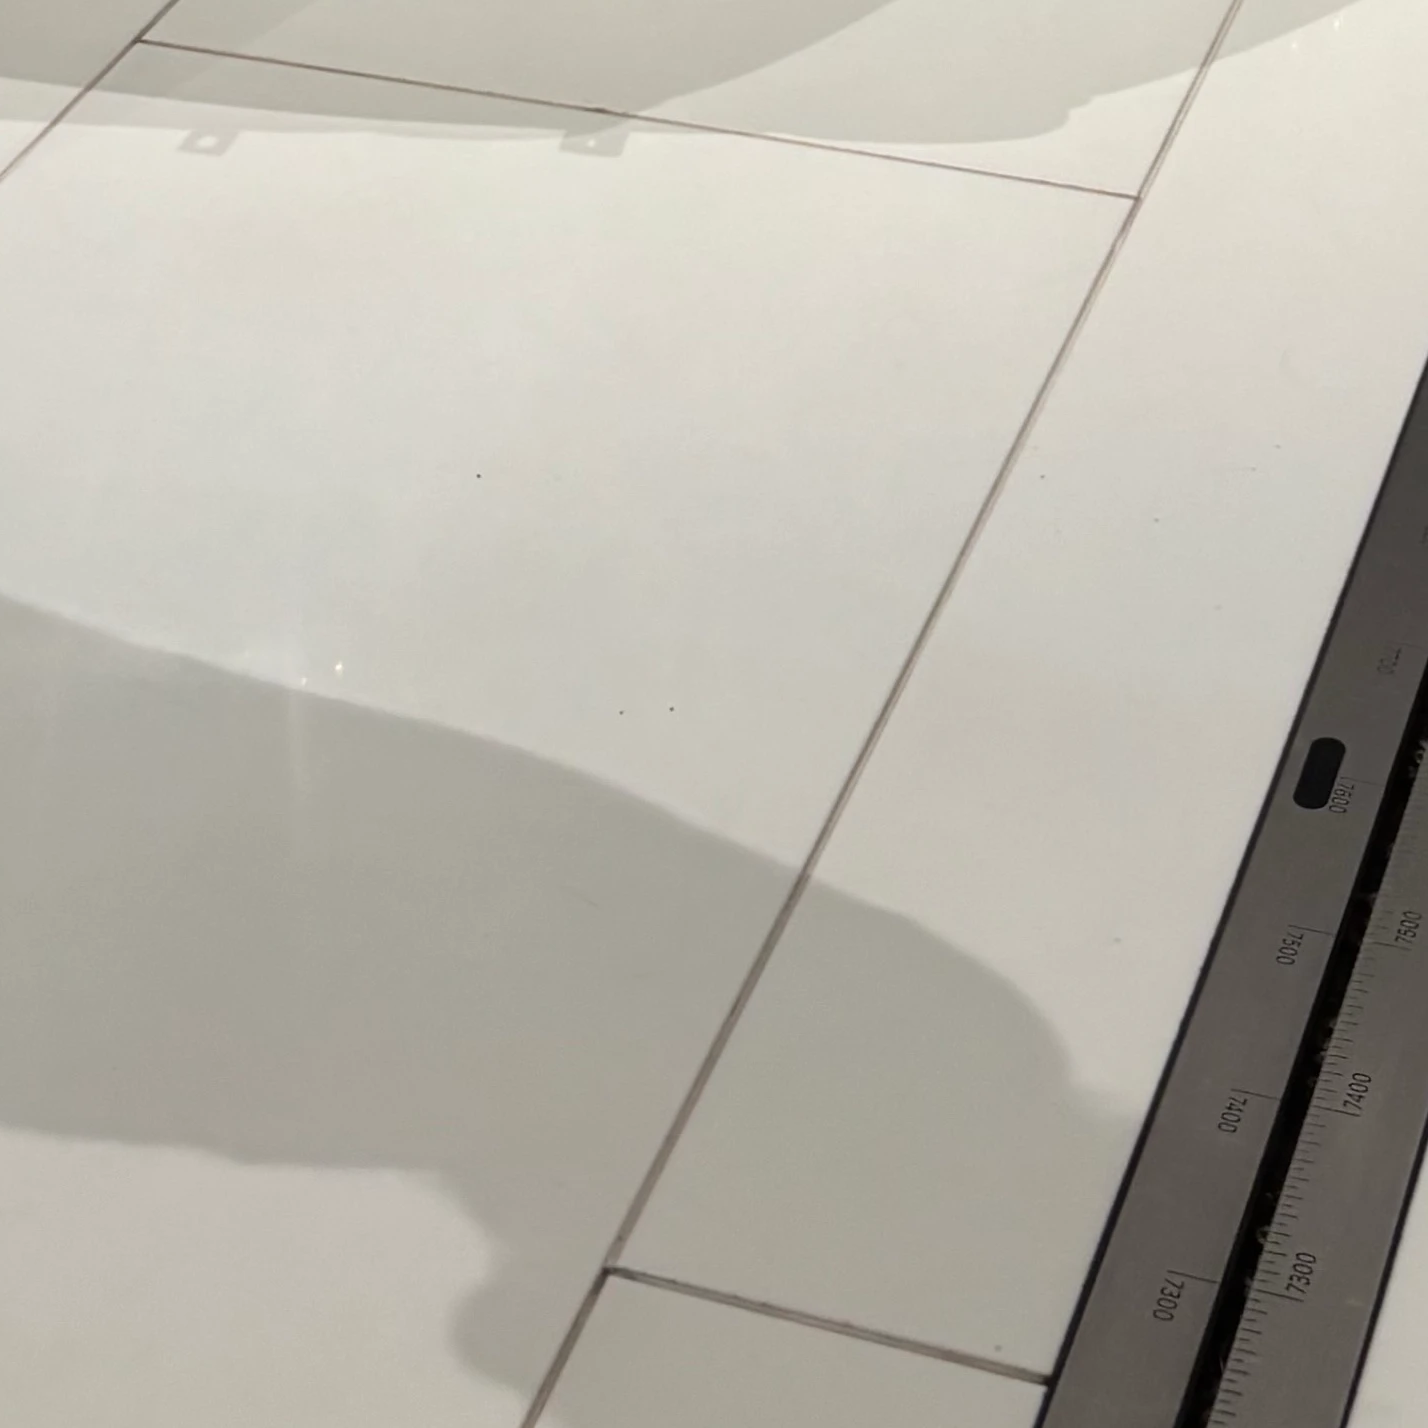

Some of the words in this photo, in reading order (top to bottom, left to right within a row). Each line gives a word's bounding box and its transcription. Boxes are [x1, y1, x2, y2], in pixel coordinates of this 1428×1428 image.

[1276, 932, 1304, 966] 7500
[1345, 1072, 1373, 1111] 7400
[1218, 1095, 1247, 1133] 7400
[1286, 1252, 1317, 1297] 7300
[1152, 1277, 1185, 1322] 7300
